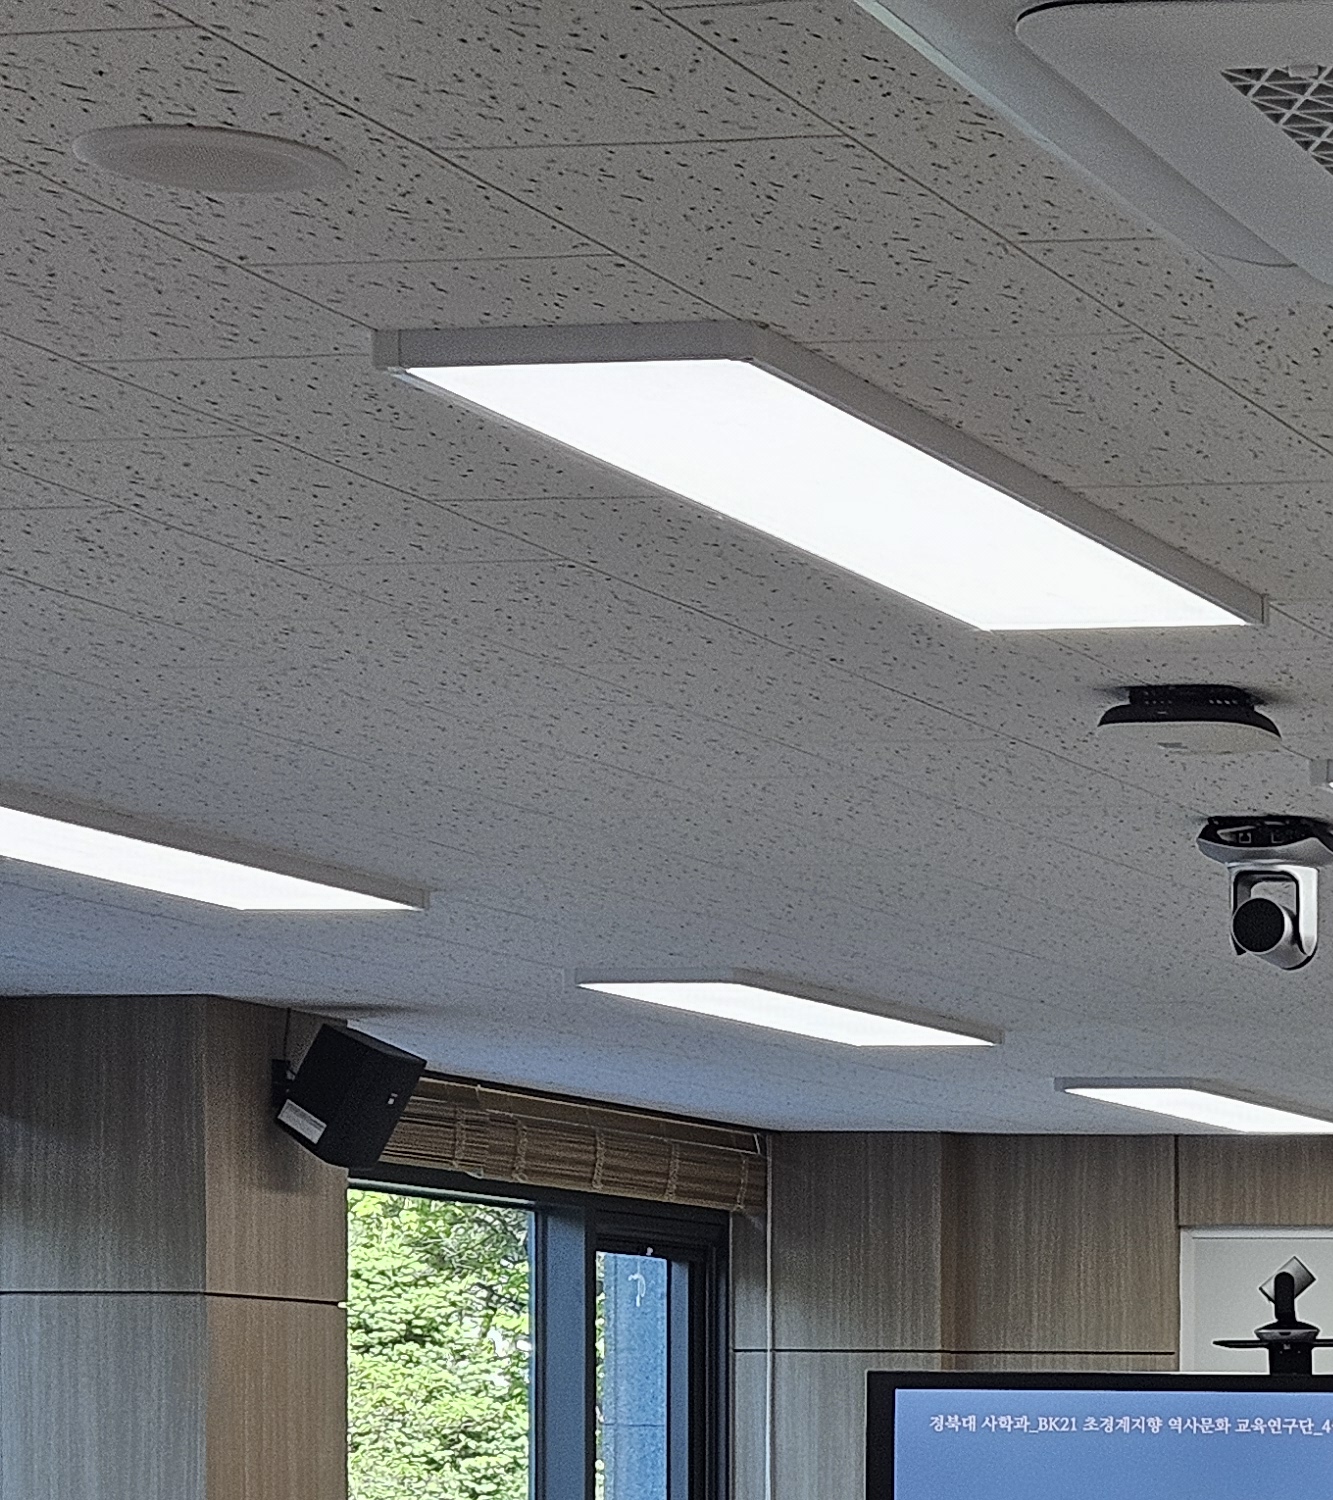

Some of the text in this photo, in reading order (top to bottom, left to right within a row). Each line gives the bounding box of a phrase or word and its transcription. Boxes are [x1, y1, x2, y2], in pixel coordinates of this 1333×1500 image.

[929, 1415, 976, 1432] 경북대
[981, 1415, 1077, 1433] 사학과_BK21
[1168, 1416, 1231, 1434] 역사문화
